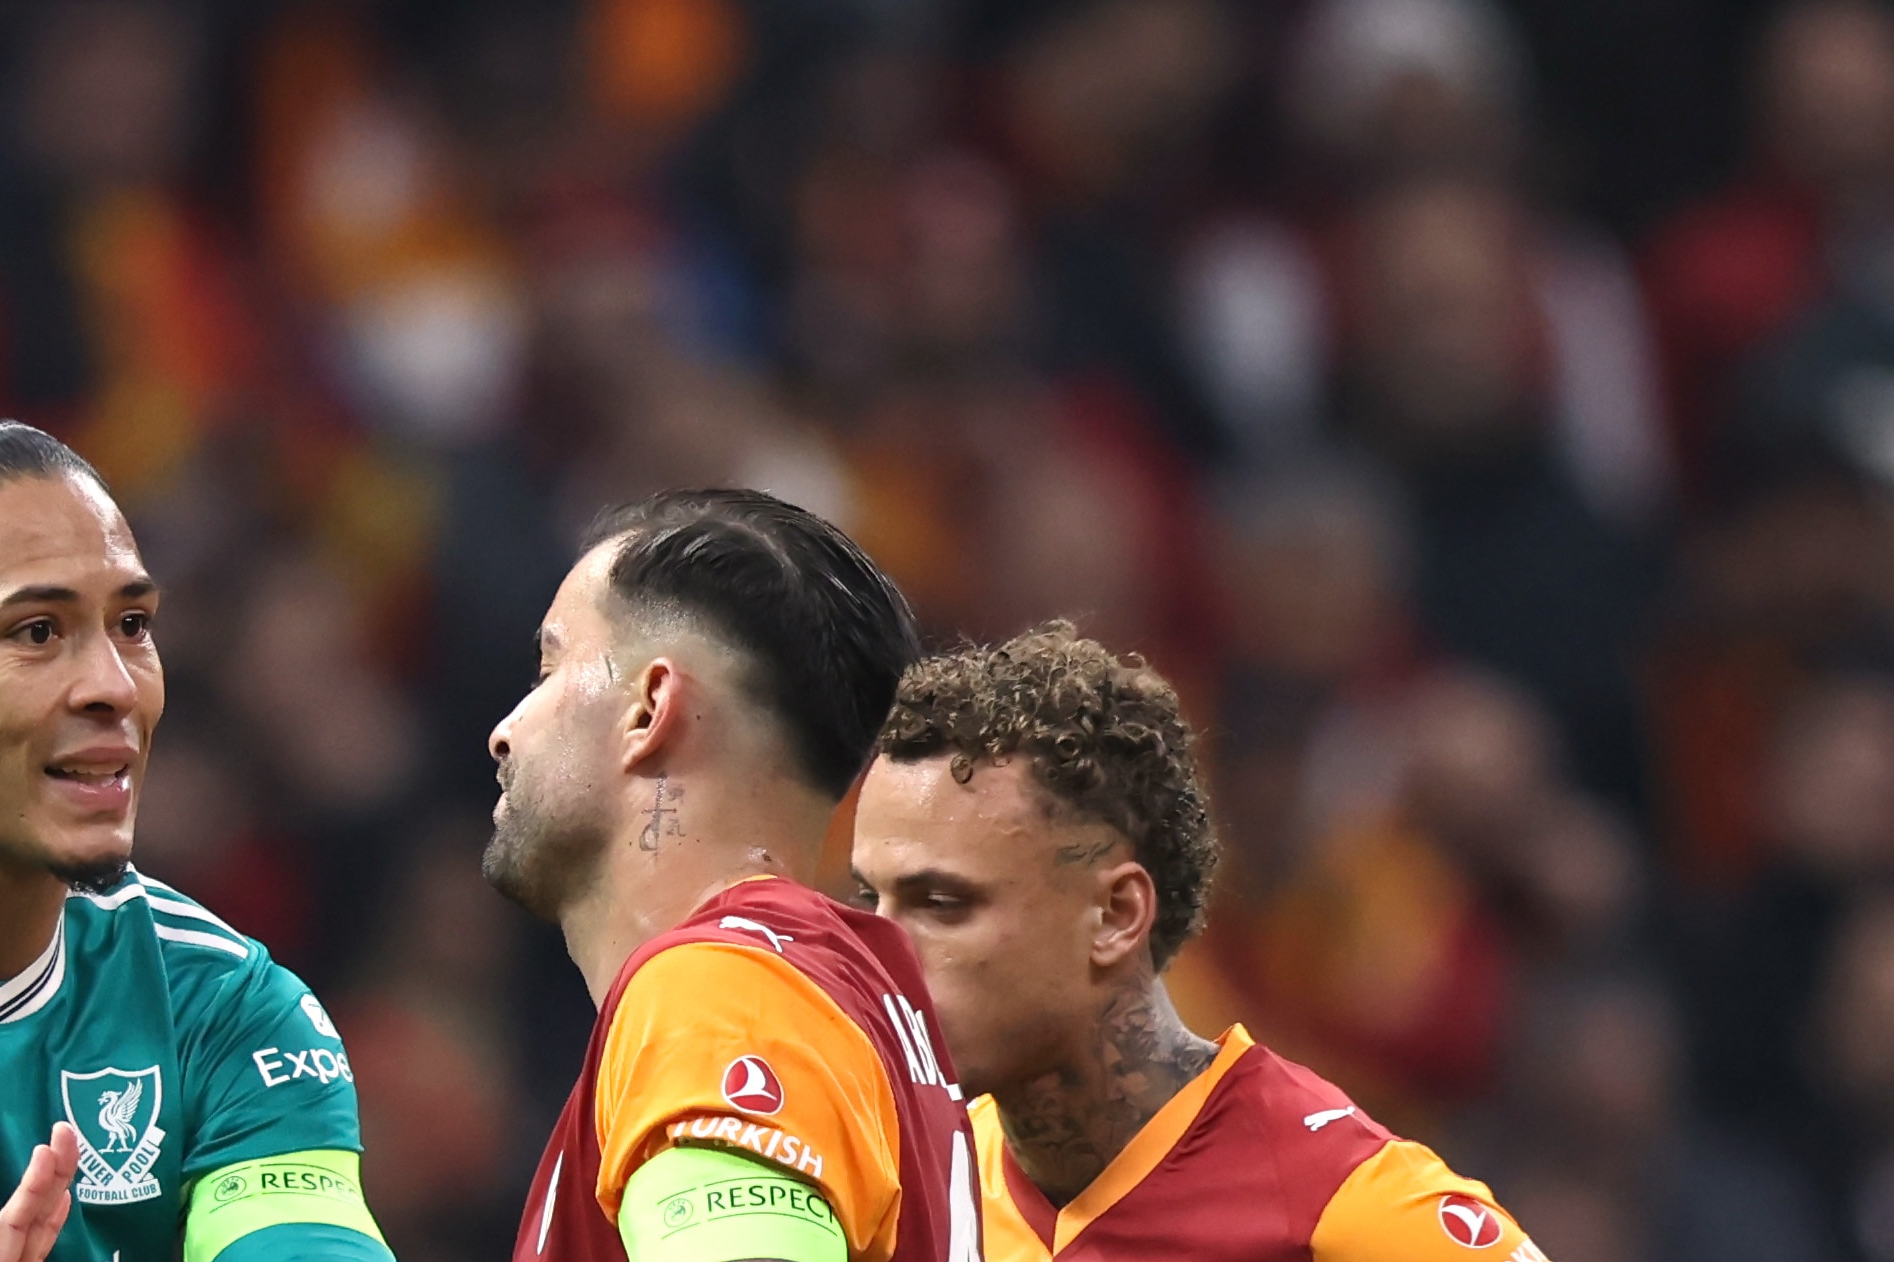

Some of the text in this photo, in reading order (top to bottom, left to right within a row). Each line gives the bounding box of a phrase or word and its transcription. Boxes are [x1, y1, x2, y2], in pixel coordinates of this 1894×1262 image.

[121, 1146, 155, 1184] POOL
[78, 1183, 157, 1201] FOOTBALL CLUB
